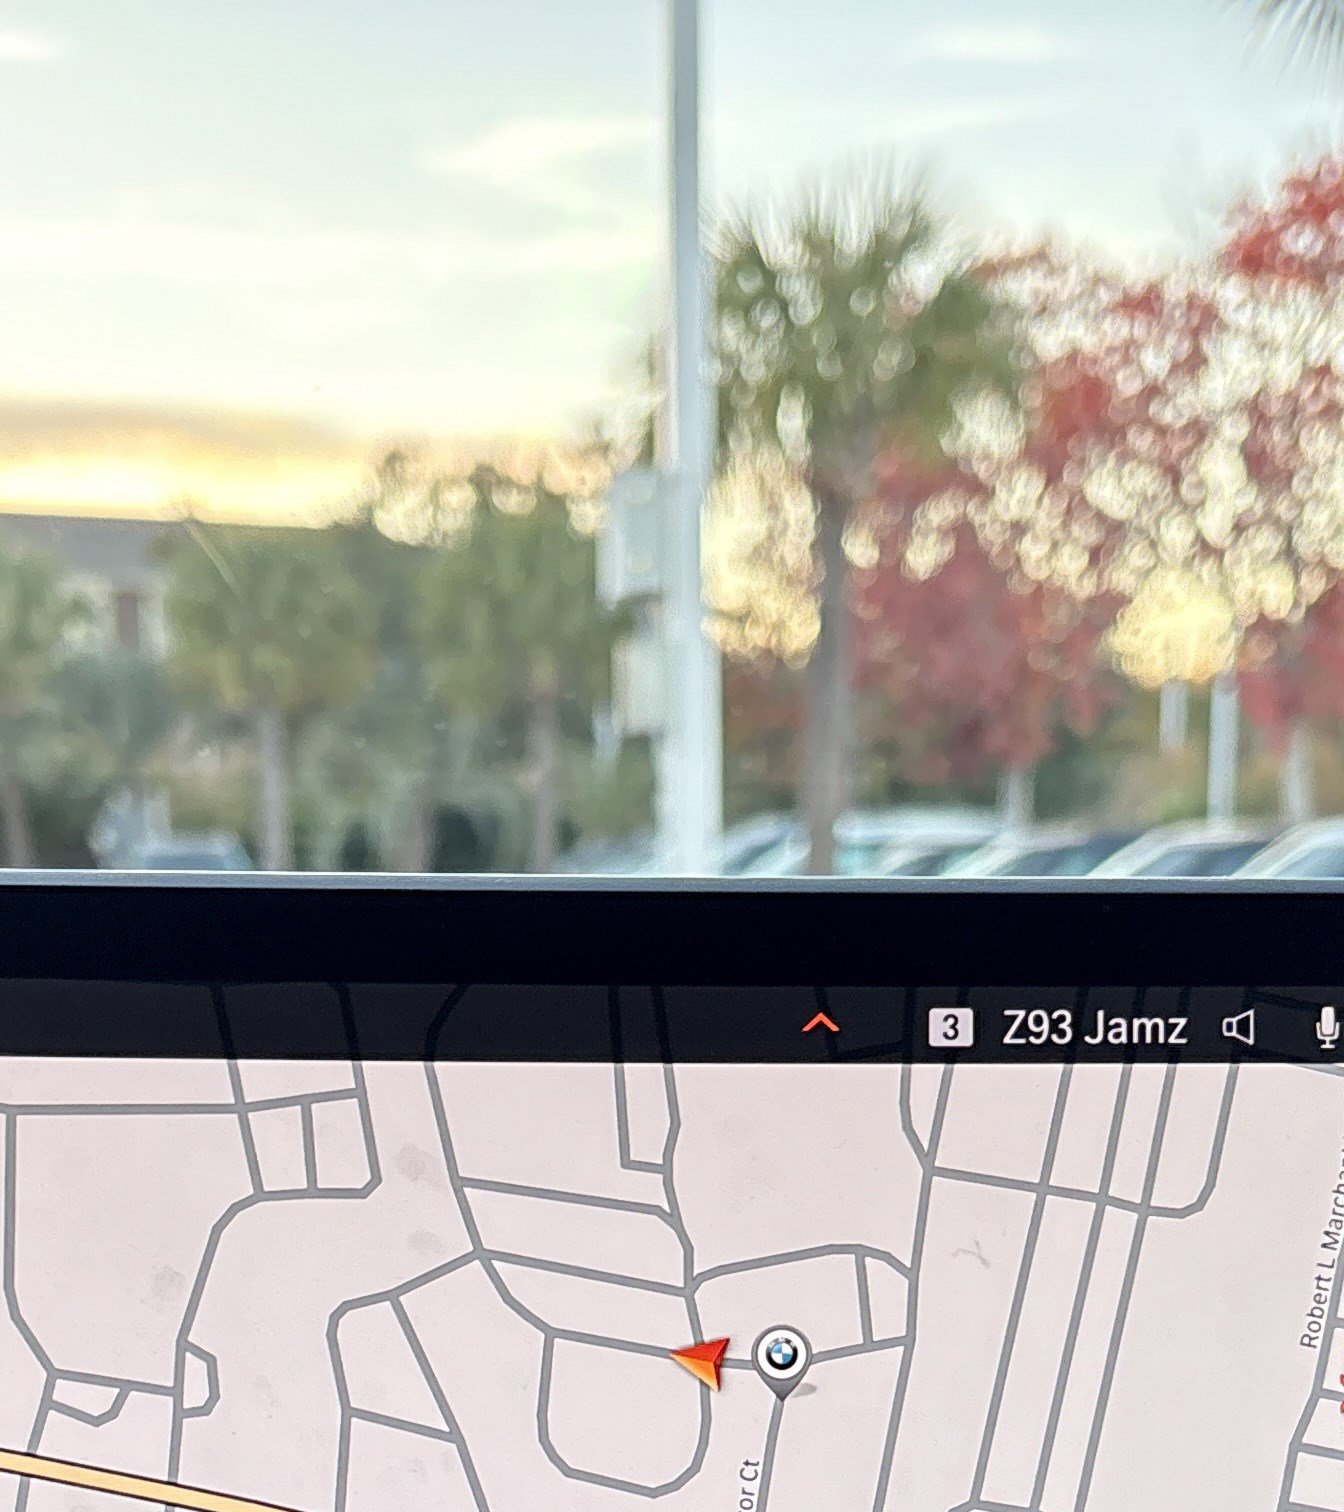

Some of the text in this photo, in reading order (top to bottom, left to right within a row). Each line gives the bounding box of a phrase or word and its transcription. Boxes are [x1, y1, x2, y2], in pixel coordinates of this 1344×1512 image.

[943, 1014, 959, 1040] 3
[1003, 1009, 1188, 1044] Z93 Jamz
[1300, 1274, 1332, 1349] Robert
[1317, 1258, 1336, 1269] L
[739, 1459, 760, 1481] Ct
